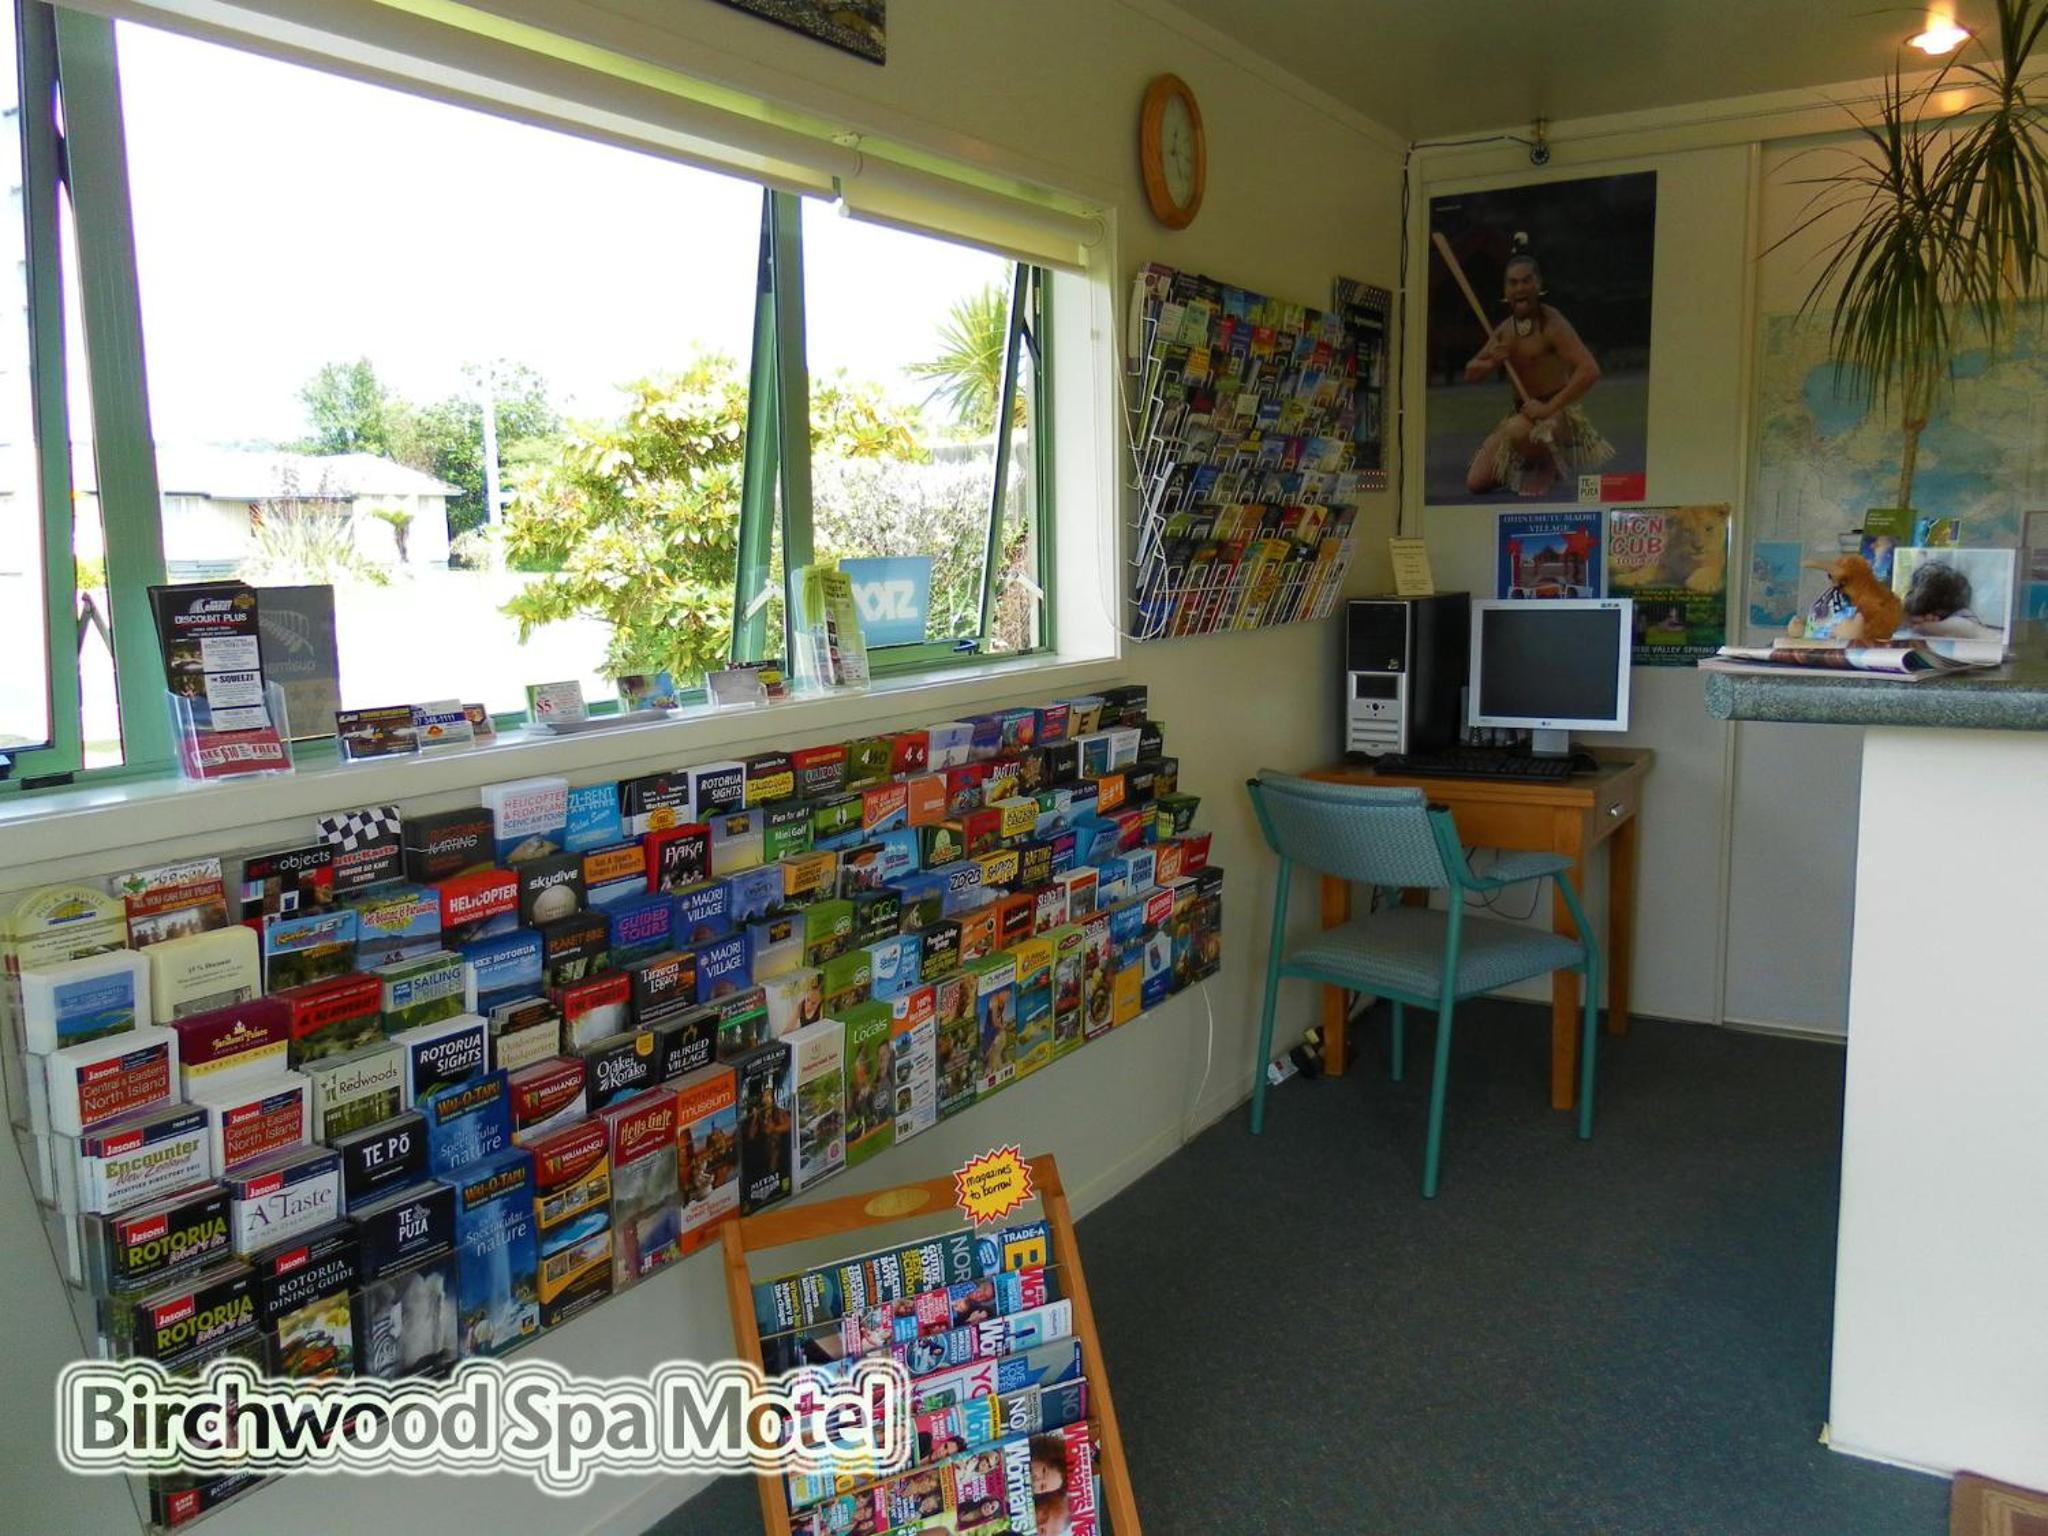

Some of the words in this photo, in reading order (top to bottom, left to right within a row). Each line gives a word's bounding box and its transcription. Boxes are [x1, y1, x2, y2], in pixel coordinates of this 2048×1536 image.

[1612, 536, 1663, 554] CUB
[174, 614, 221, 624] DISCOUNT
[223, 613, 247, 622] PLUS
[219, 674, 254, 683] SQUEEZE
[252, 743, 278, 753] FREE
[701, 774, 742, 790] ROTORUA
[711, 786, 742, 800] SIGHTS
[772, 813, 786, 824] Fun
[787, 811, 797, 821] for
[428, 835, 478, 854] KARTING
[775, 829, 791, 841] Mini
[792, 825, 808, 837] Golf
[280, 849, 330, 871] objects
[665, 840, 703, 867] HAKA
[529, 868, 578, 891] skydive
[691, 887, 723, 908] MAORI
[618, 907, 668, 931] GUIDED
[687, 903, 723, 923] VILLAGE
[619, 920, 668, 943] TOURS
[494, 944, 536, 964] ROTORUA
[711, 941, 741, 962] MAORI
[414, 967, 461, 990] SAILING
[705, 958, 742, 979] VILLAGE
[650, 972, 680, 994] Legacy
[854, 1017, 887, 1045] Locals
[420, 1033, 481, 1065] ROTORUA
[436, 1048, 481, 1072] SIGHTS
[669, 1038, 709, 1062] BURIED
[88, 1065, 121, 1081] Jasons
[597, 1053, 635, 1079] Orakei
[668, 1052, 708, 1072] VILLAGE
[82, 1078, 120, 1099] Central
[128, 1064, 167, 1084] Eastern
[339, 1060, 398, 1095] Redwoods
[609, 1063, 647, 1089] Korako
[85, 1090, 124, 1112] North
[128, 1075, 167, 1098] Island
[232, 1110, 260, 1124] Jasons
[681, 1091, 731, 1121] museum
[227, 1124, 260, 1140] Central
[267, 1108, 300, 1126] Eastern
[106, 1139, 142, 1155] Jasons
[228, 1133, 262, 1153] North
[265, 1121, 300, 1140] Island
[105, 1138, 200, 1179] Encounter
[362, 1146, 384, 1167] TE
[450, 1136, 502, 1168] nature
[249, 1182, 281, 1197] Jasons
[970, 1188, 981, 1200] to
[982, 1178, 1012, 1196] borrow
[248, 1203, 269, 1233] A
[269, 1188, 330, 1218] Taste
[398, 1207, 413, 1226] TE
[129, 1225, 165, 1244] Jasons
[129, 1216, 227, 1268] ROTORUA
[399, 1218, 429, 1243] PUIA
[477, 1222, 527, 1257] nature
[279, 1254, 307, 1272] Jasons
[879, 1255, 890, 1287] BOYS
[910, 1247, 923, 1281] BEST
[927, 1243, 940, 1284] GUIDE
[278, 1259, 345, 1296] ROTORUA
[269, 1284, 315, 1312] DINING
[318, 1268, 354, 1290] GUIDE
[157, 1295, 254, 1350] ROTORUA
[158, 1306, 193, 1327] Jasons
[1012, 1360, 1025, 1383] LIVE
